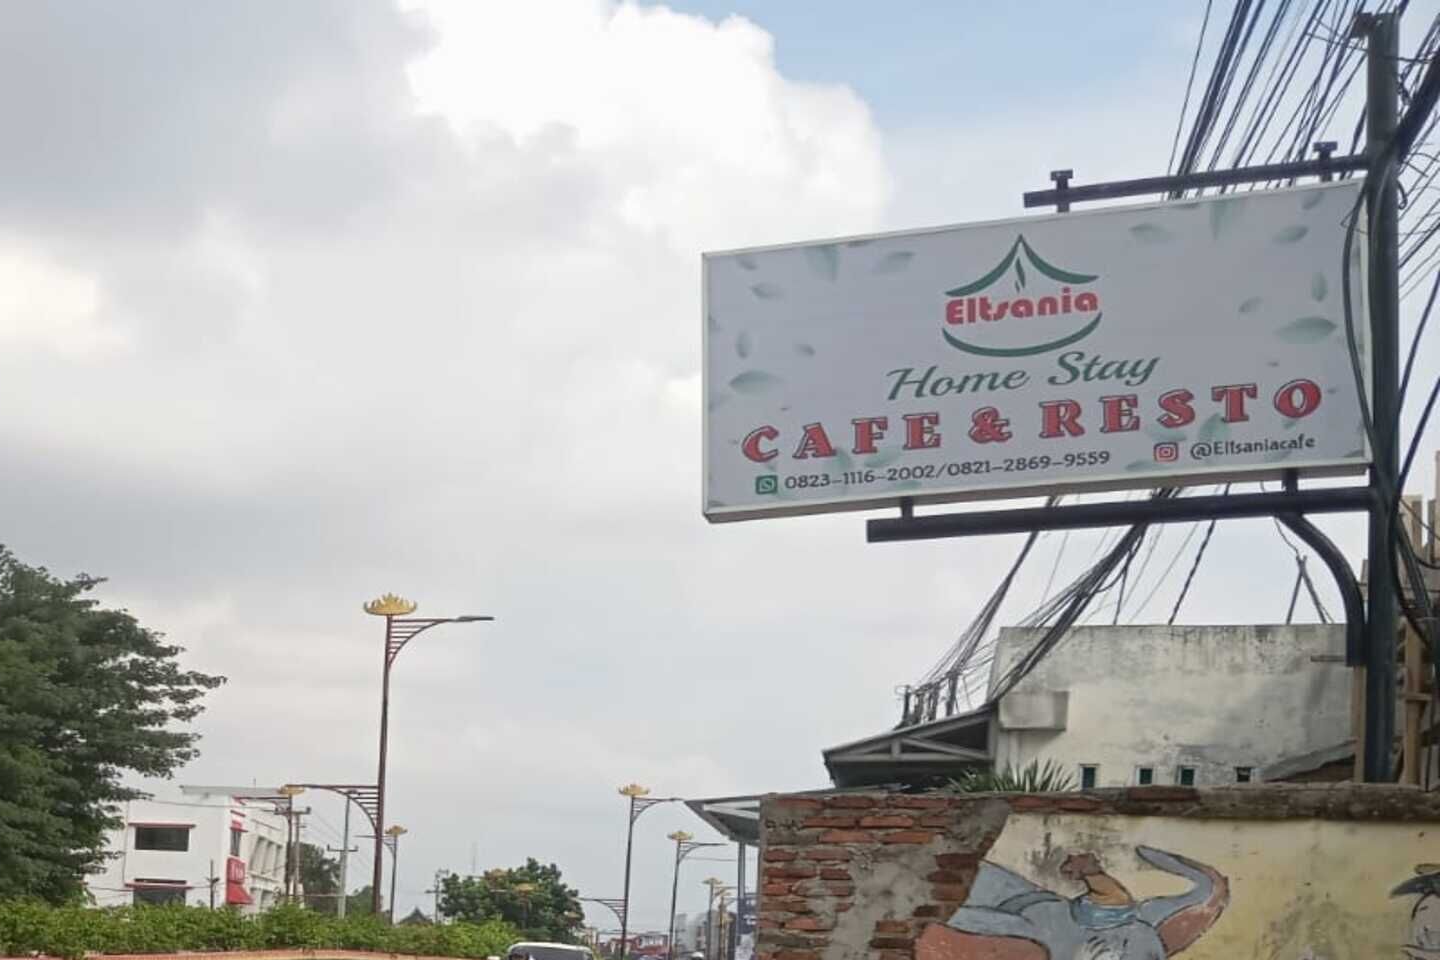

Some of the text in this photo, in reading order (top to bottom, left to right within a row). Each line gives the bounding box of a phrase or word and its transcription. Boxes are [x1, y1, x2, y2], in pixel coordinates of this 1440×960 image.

[946, 286, 1099, 325] Eltsania
[886, 350, 1160, 401] Home Stay
[741, 378, 1322, 463] CAFE & RESTO
